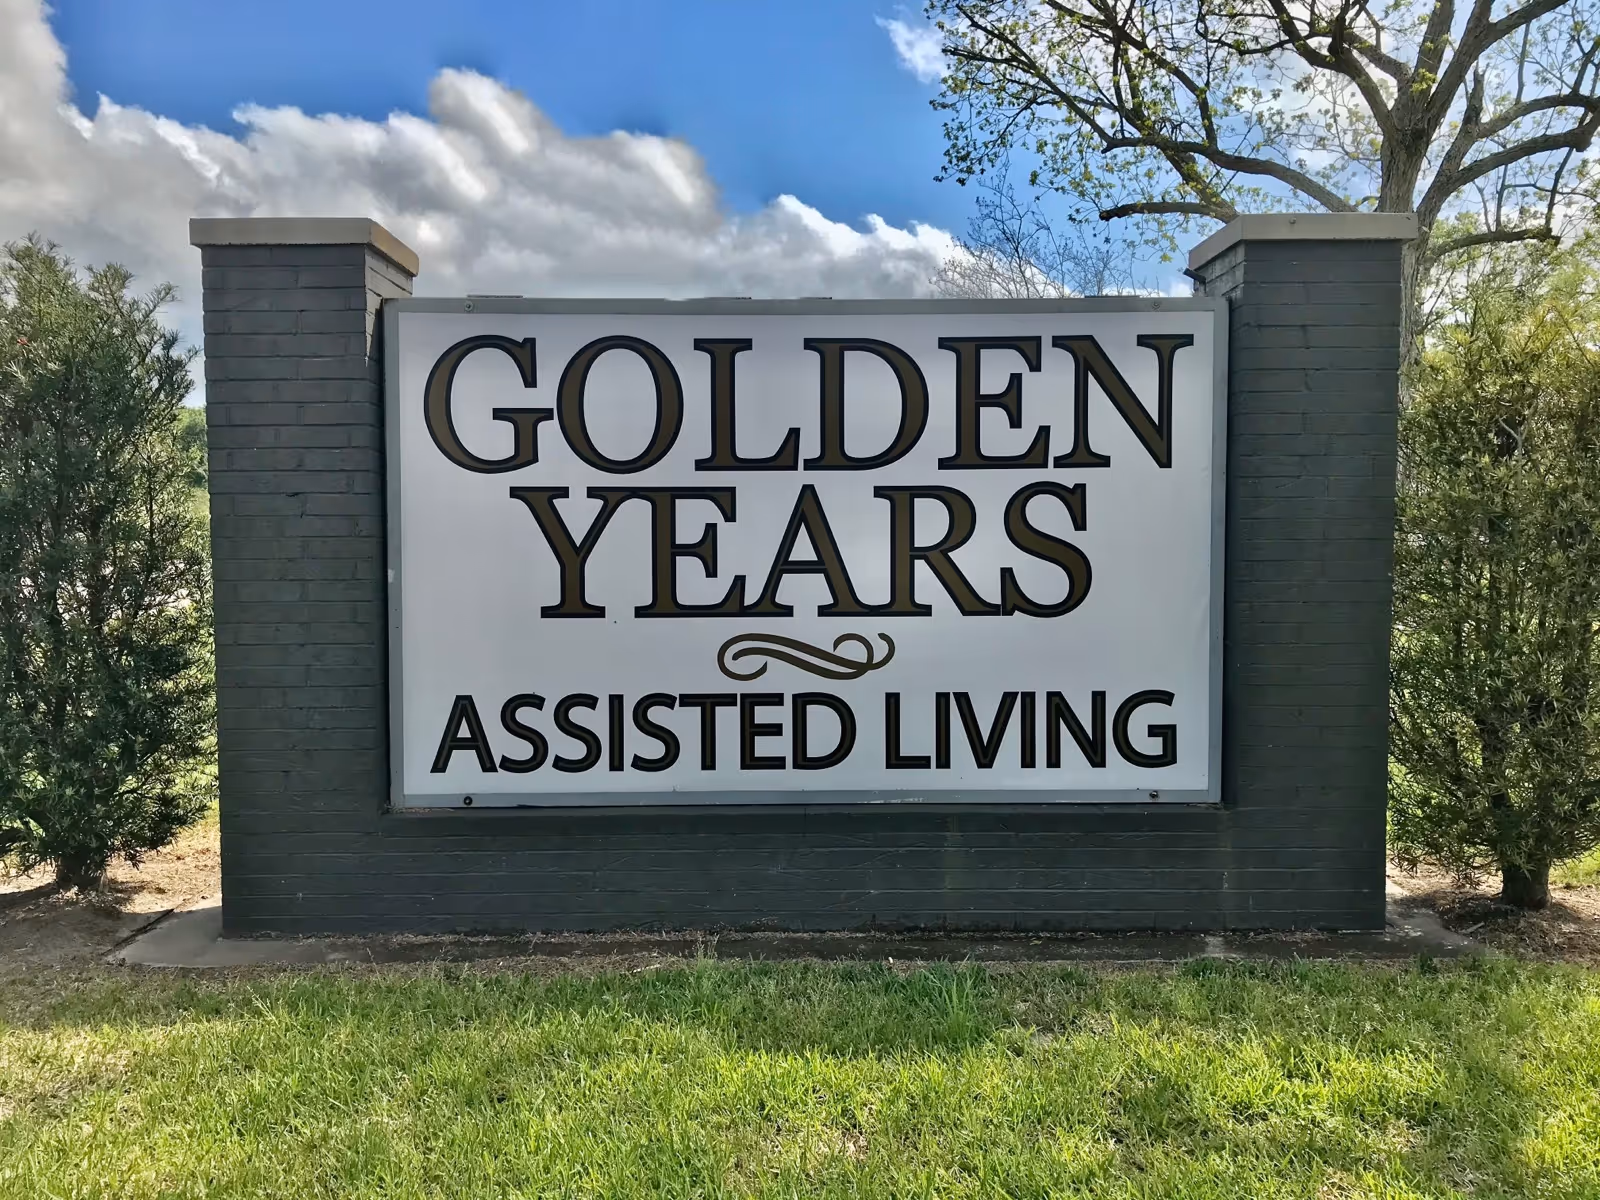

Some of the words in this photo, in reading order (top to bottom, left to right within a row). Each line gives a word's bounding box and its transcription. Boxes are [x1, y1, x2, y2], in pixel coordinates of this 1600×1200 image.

[424, 334, 1194, 474] GOLDEN
[510, 481, 1092, 618] YEARS
[430, 692, 857, 774] ASSISTED
[885, 690, 1178, 770] LIVING
